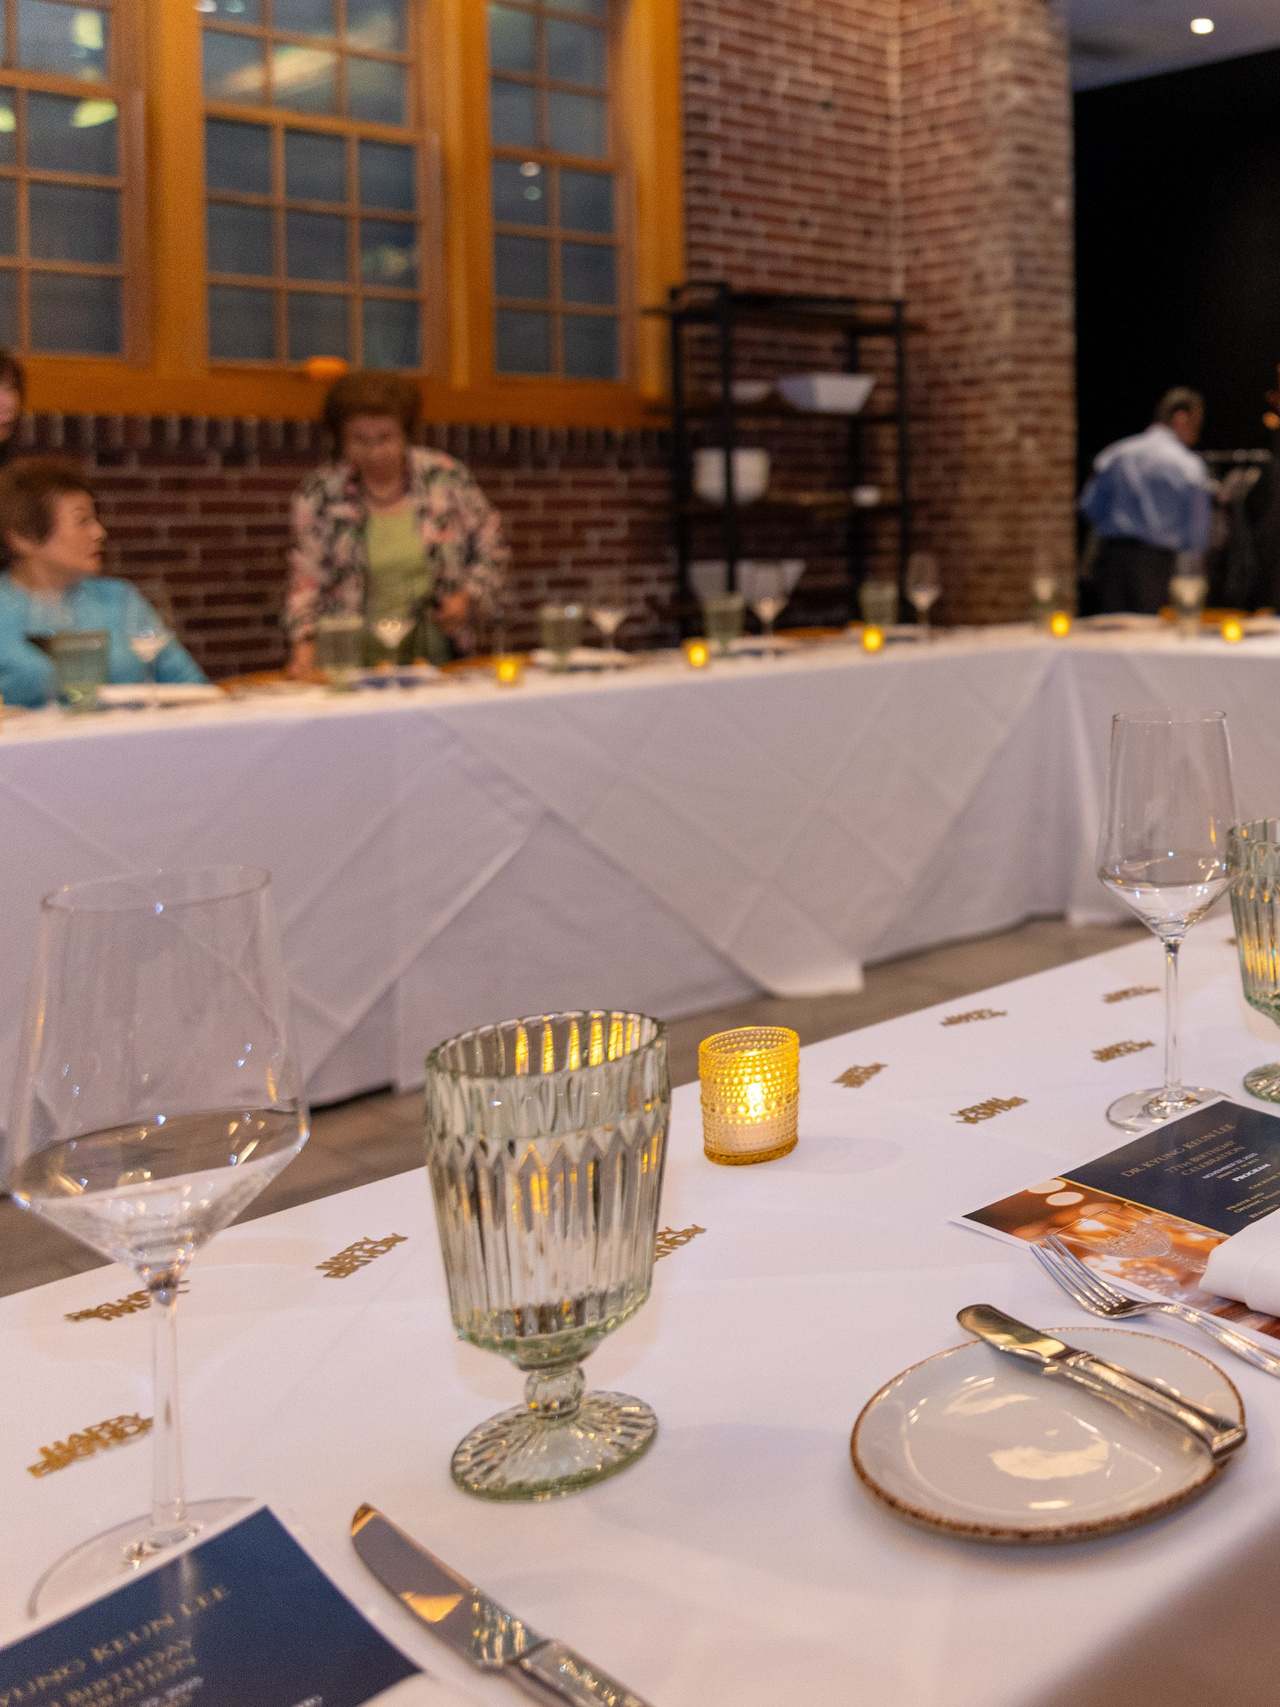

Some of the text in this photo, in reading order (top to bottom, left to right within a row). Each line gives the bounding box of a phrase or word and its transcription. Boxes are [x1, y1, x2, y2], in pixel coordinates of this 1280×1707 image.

[1141, 1147, 1186, 1169] KYUNG
[1182, 1133, 1216, 1150] KEUN
[1213, 1122, 1237, 1135] LEE
[1188, 1139, 1237, 1163] BIRTHDAY
[1181, 1146, 1245, 1176] CELEBRATION
[1231, 1163, 1272, 1182] PROGRAM
[180, 1584, 232, 1618] LEE
